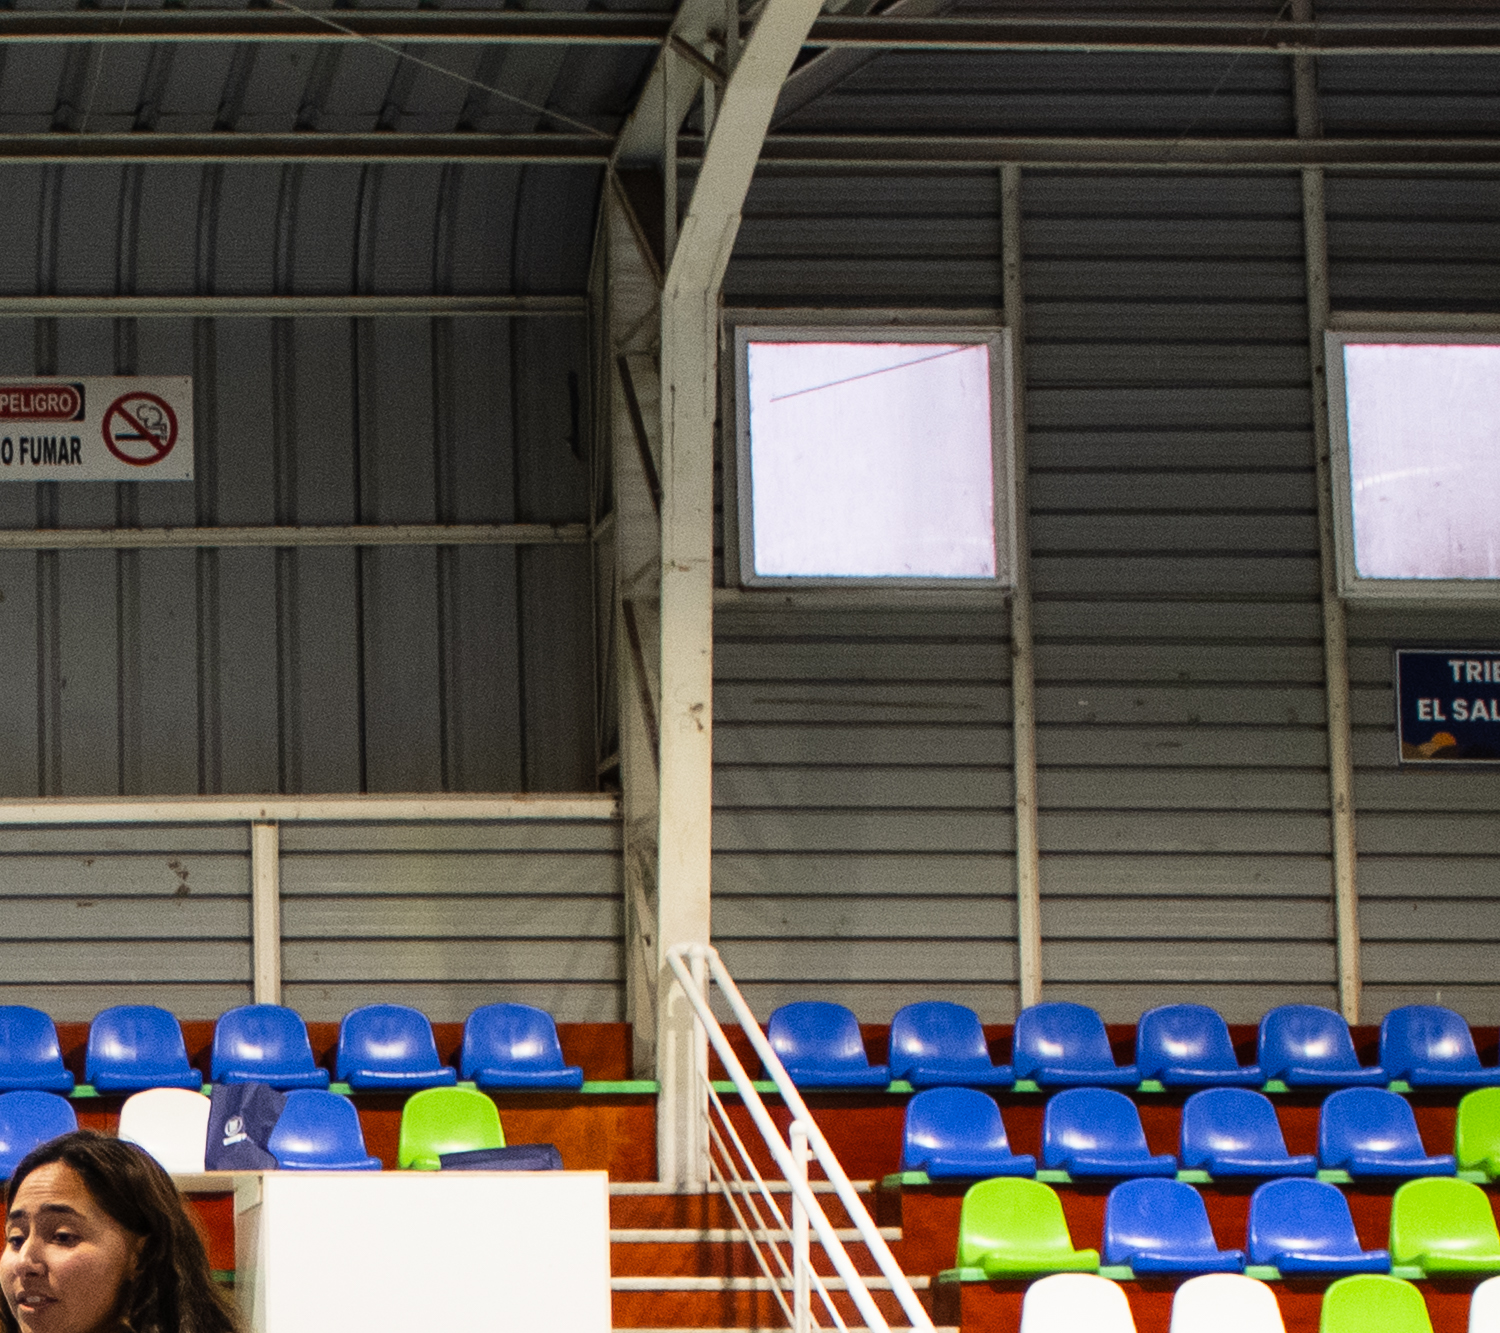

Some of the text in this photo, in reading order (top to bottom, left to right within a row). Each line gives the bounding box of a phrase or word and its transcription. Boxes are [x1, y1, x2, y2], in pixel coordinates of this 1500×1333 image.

[0, 393, 73, 413] PELIGRO
[20, 436, 82, 465] FUMAR
[1417, 699, 1446, 722] EL
